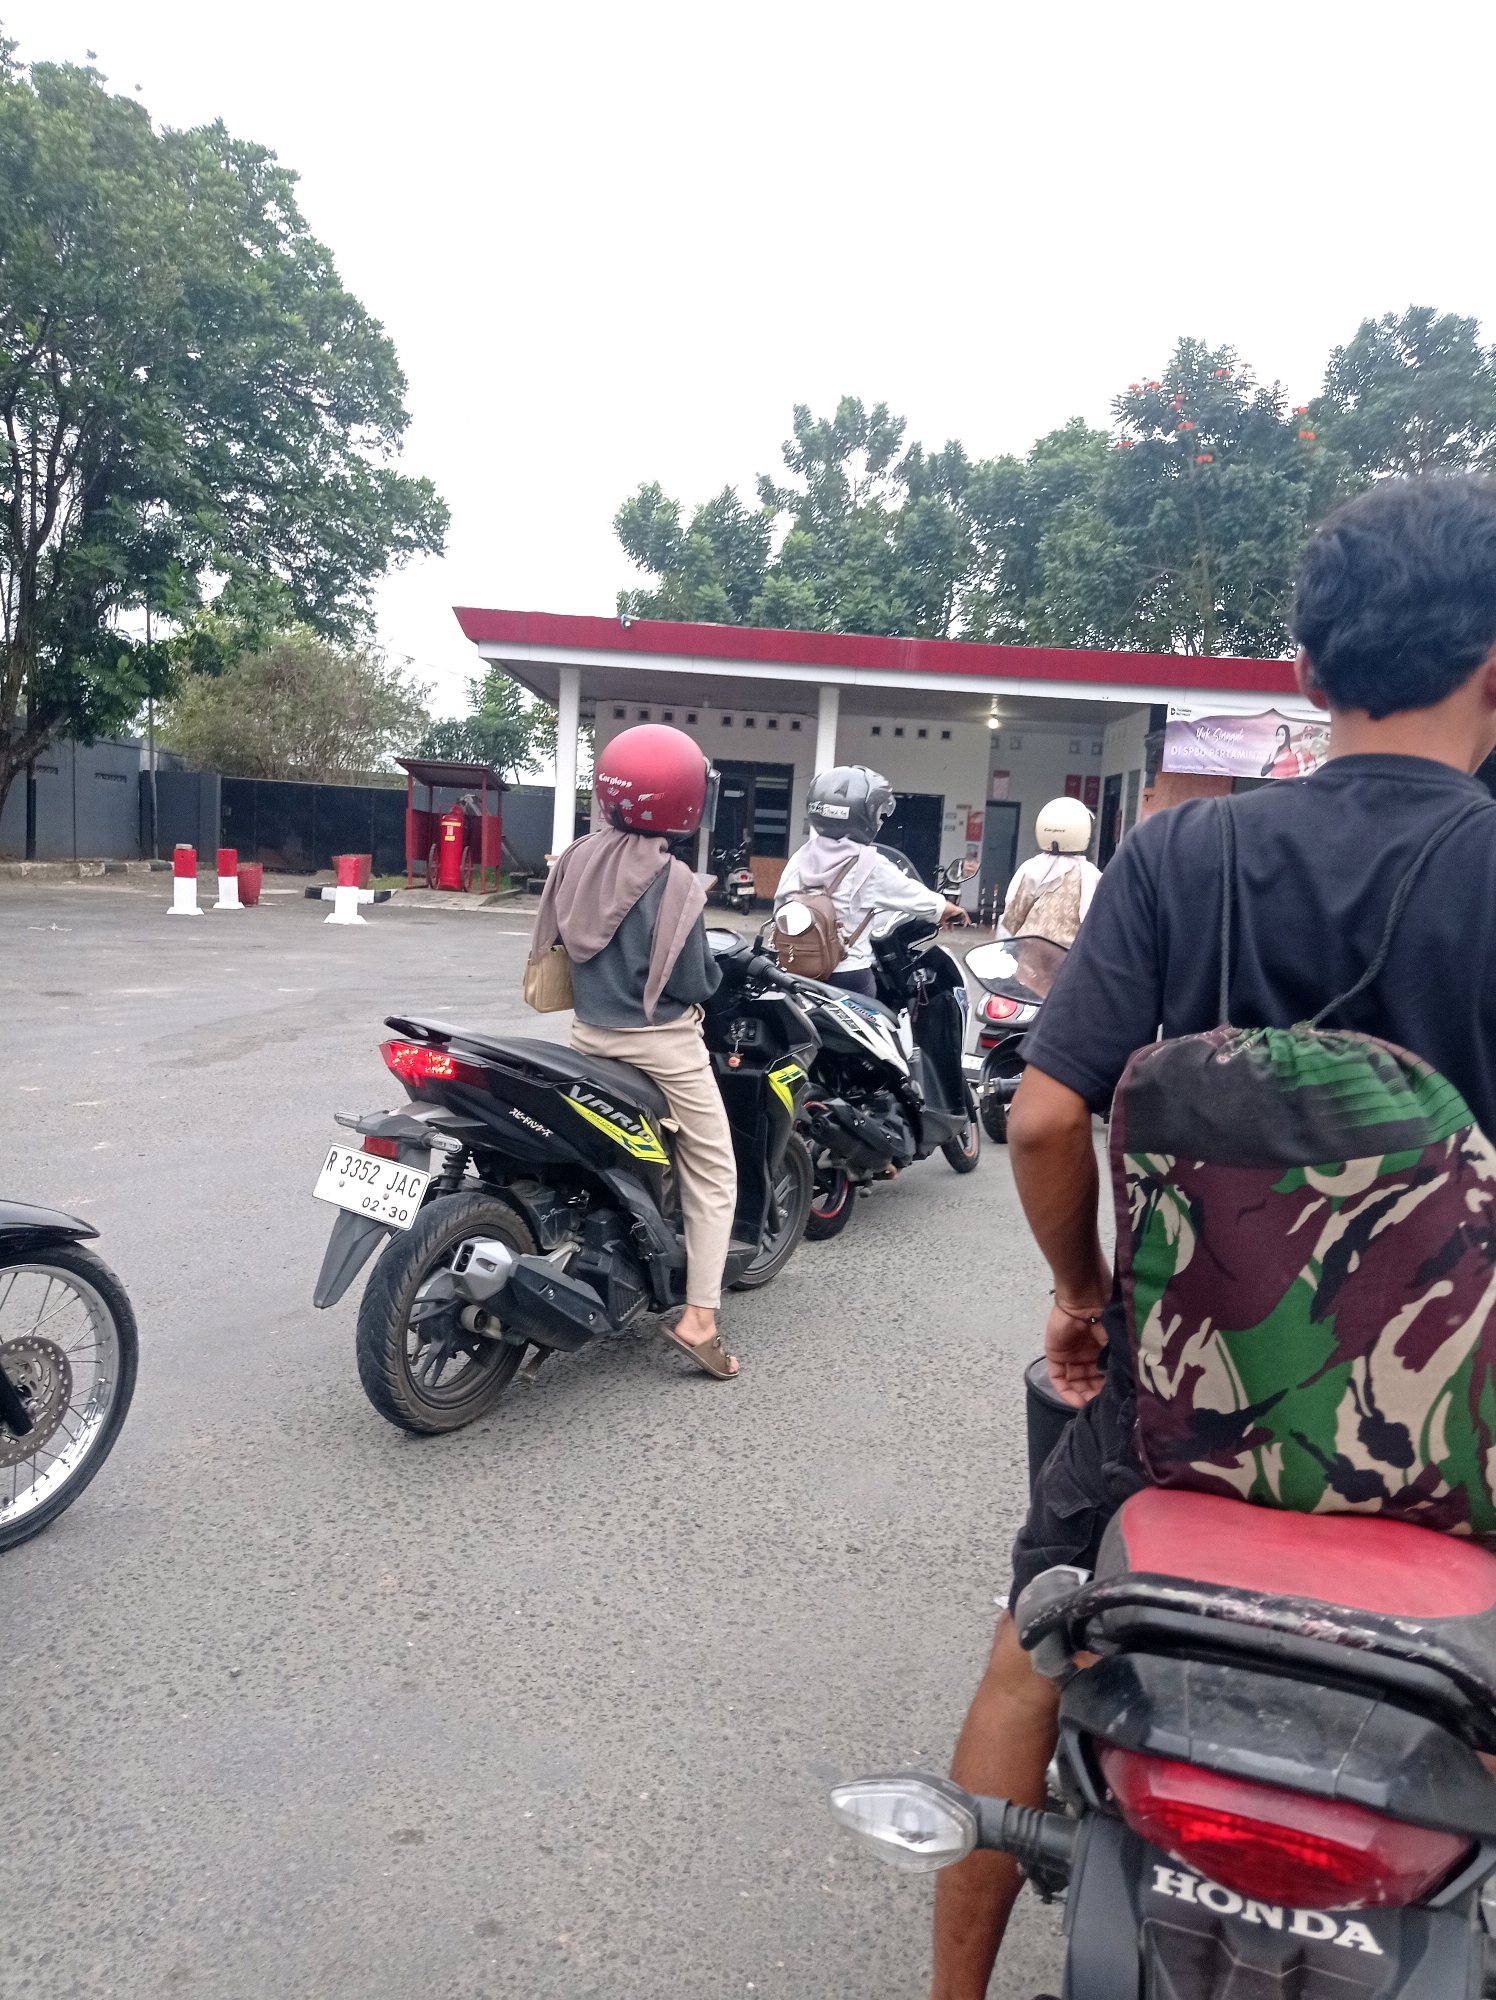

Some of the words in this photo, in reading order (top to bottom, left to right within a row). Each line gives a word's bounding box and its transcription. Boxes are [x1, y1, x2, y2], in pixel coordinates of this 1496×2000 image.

[1171, 746, 1181, 756] DI
[1183, 746, 1206, 758] SPBU
[1196, 727, 1210, 740] Yuk
[569, 1085, 655, 1143] VARIO
[326, 1150, 338, 1171] R
[340, 1155, 381, 1185] 3352
[386, 1171, 421, 1198] JAC
[1152, 1864, 1384, 1956] HONDA
